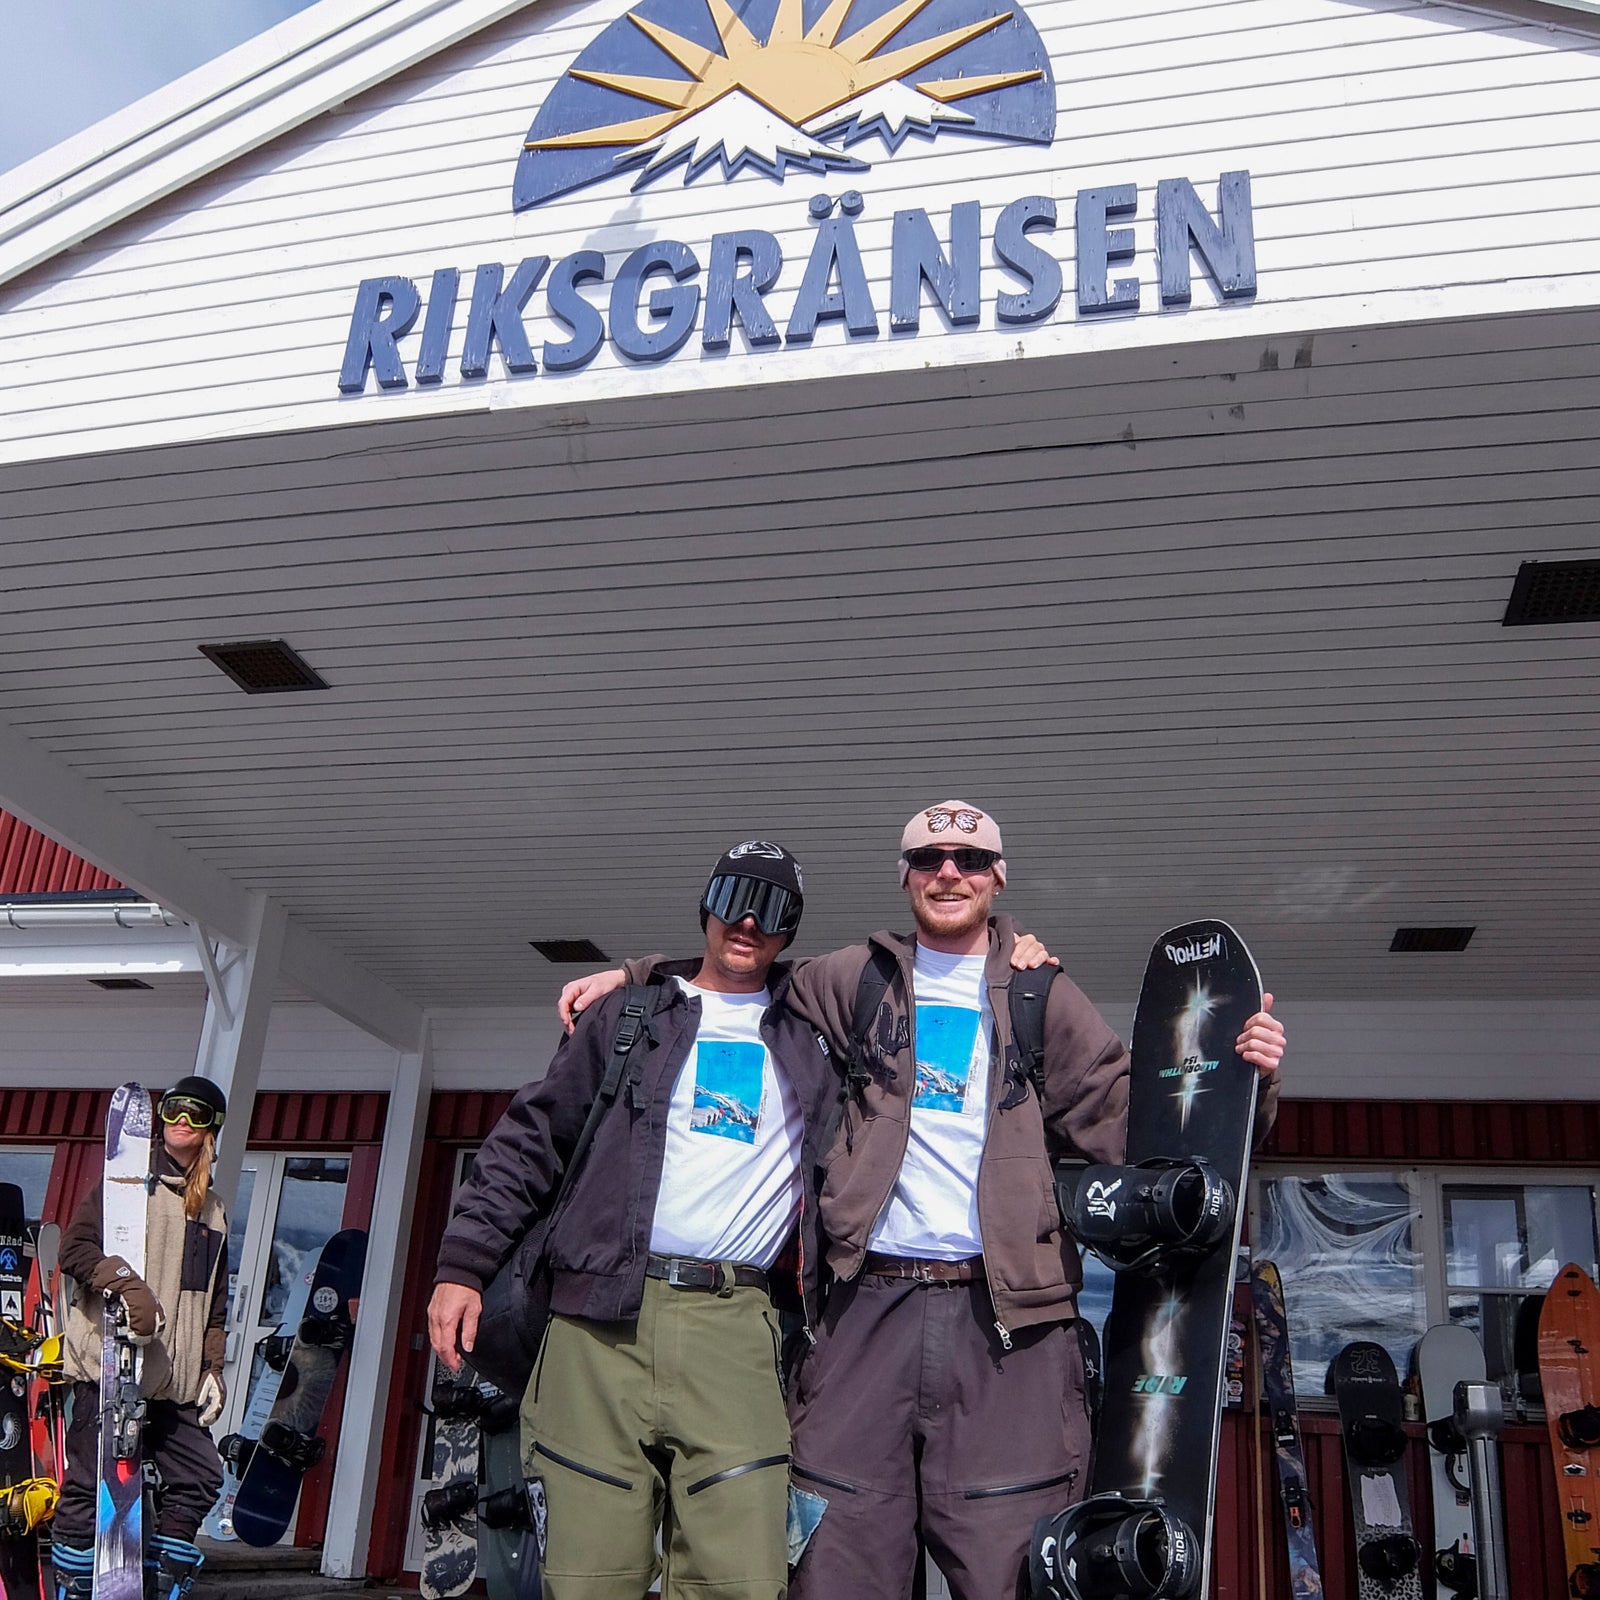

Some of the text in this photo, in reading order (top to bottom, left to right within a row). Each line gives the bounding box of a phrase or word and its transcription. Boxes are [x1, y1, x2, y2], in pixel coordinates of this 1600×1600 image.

[338, 169, 1257, 394] RIKSGRÄNSEN
[1165, 933, 1221, 966] METHOD
[1183, 1056, 1199, 1065] 154
[1210, 1187, 1222, 1217] RIDE
[1131, 1375, 1188, 1395] RIDE
[1175, 1530, 1185, 1564] RIDE
